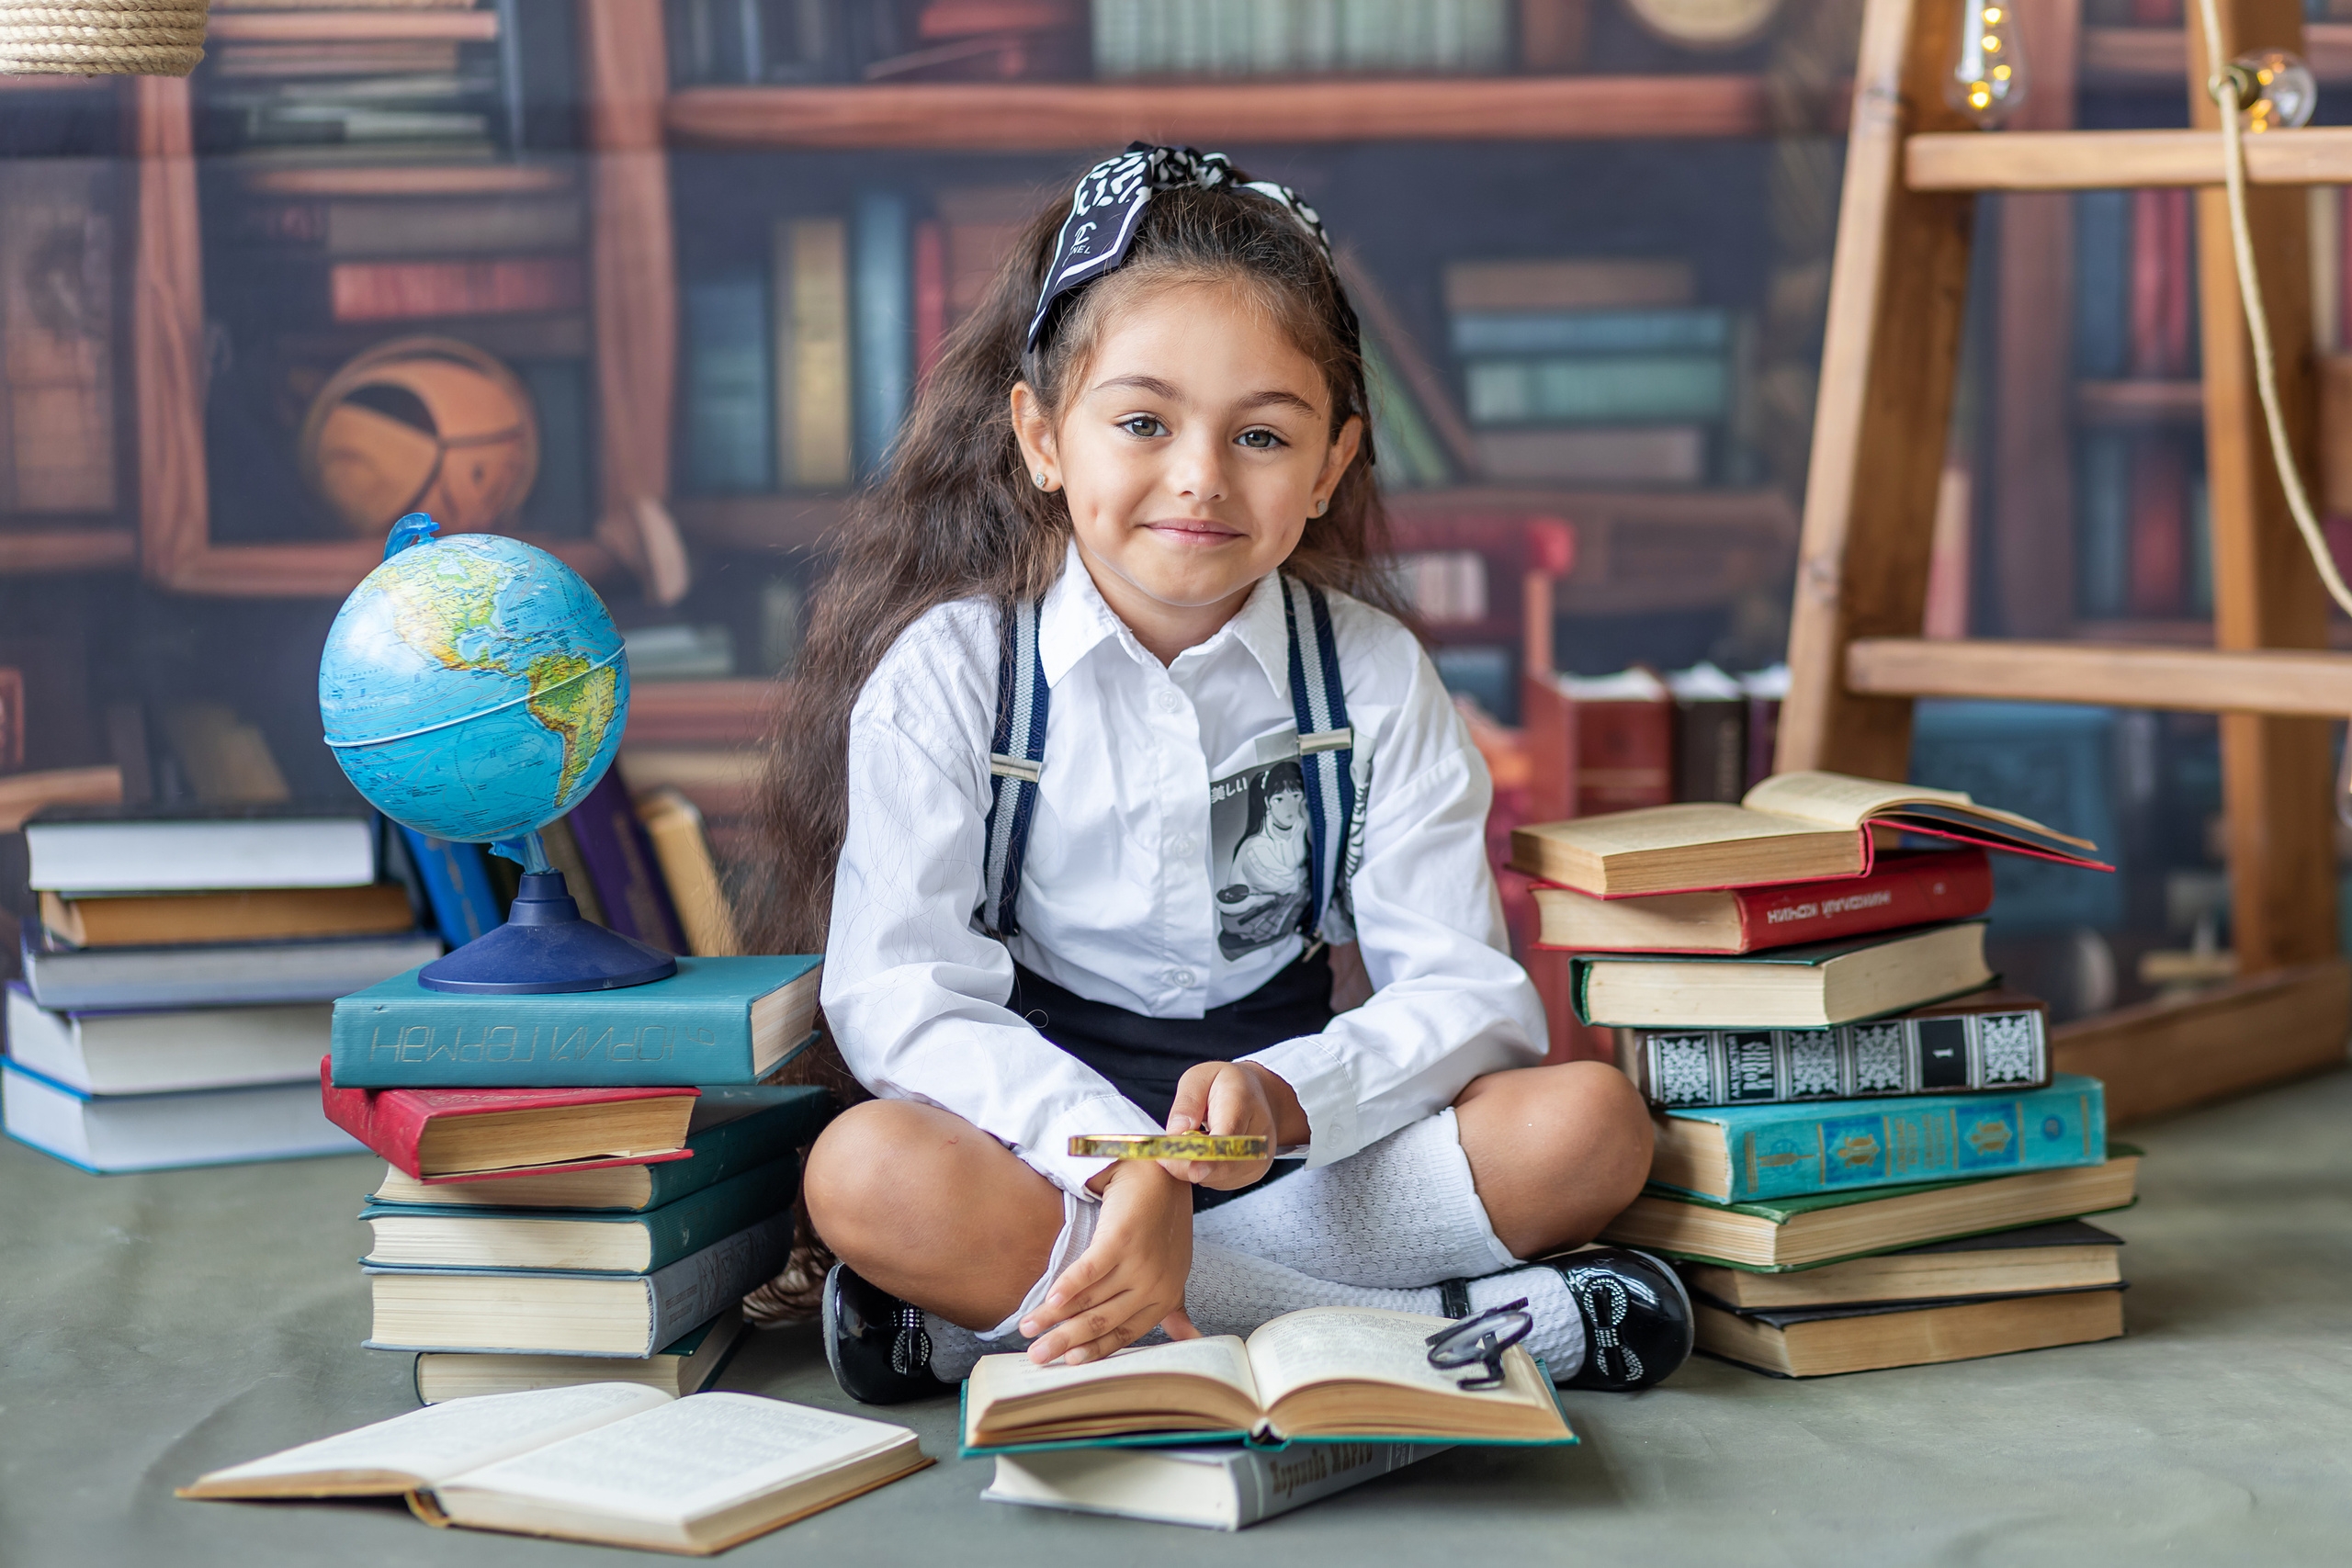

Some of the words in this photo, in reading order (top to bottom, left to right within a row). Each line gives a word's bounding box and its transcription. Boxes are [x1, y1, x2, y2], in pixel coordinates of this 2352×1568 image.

[1211, 777, 1248, 804] 美しい
[1767, 904, 1818, 924] КОЧИН
[1822, 891, 1891, 919] НИКОЛАЙ
[548, 1025, 677, 1063] ЮРИЙ
[1932, 1048, 1953, 1060] 1
